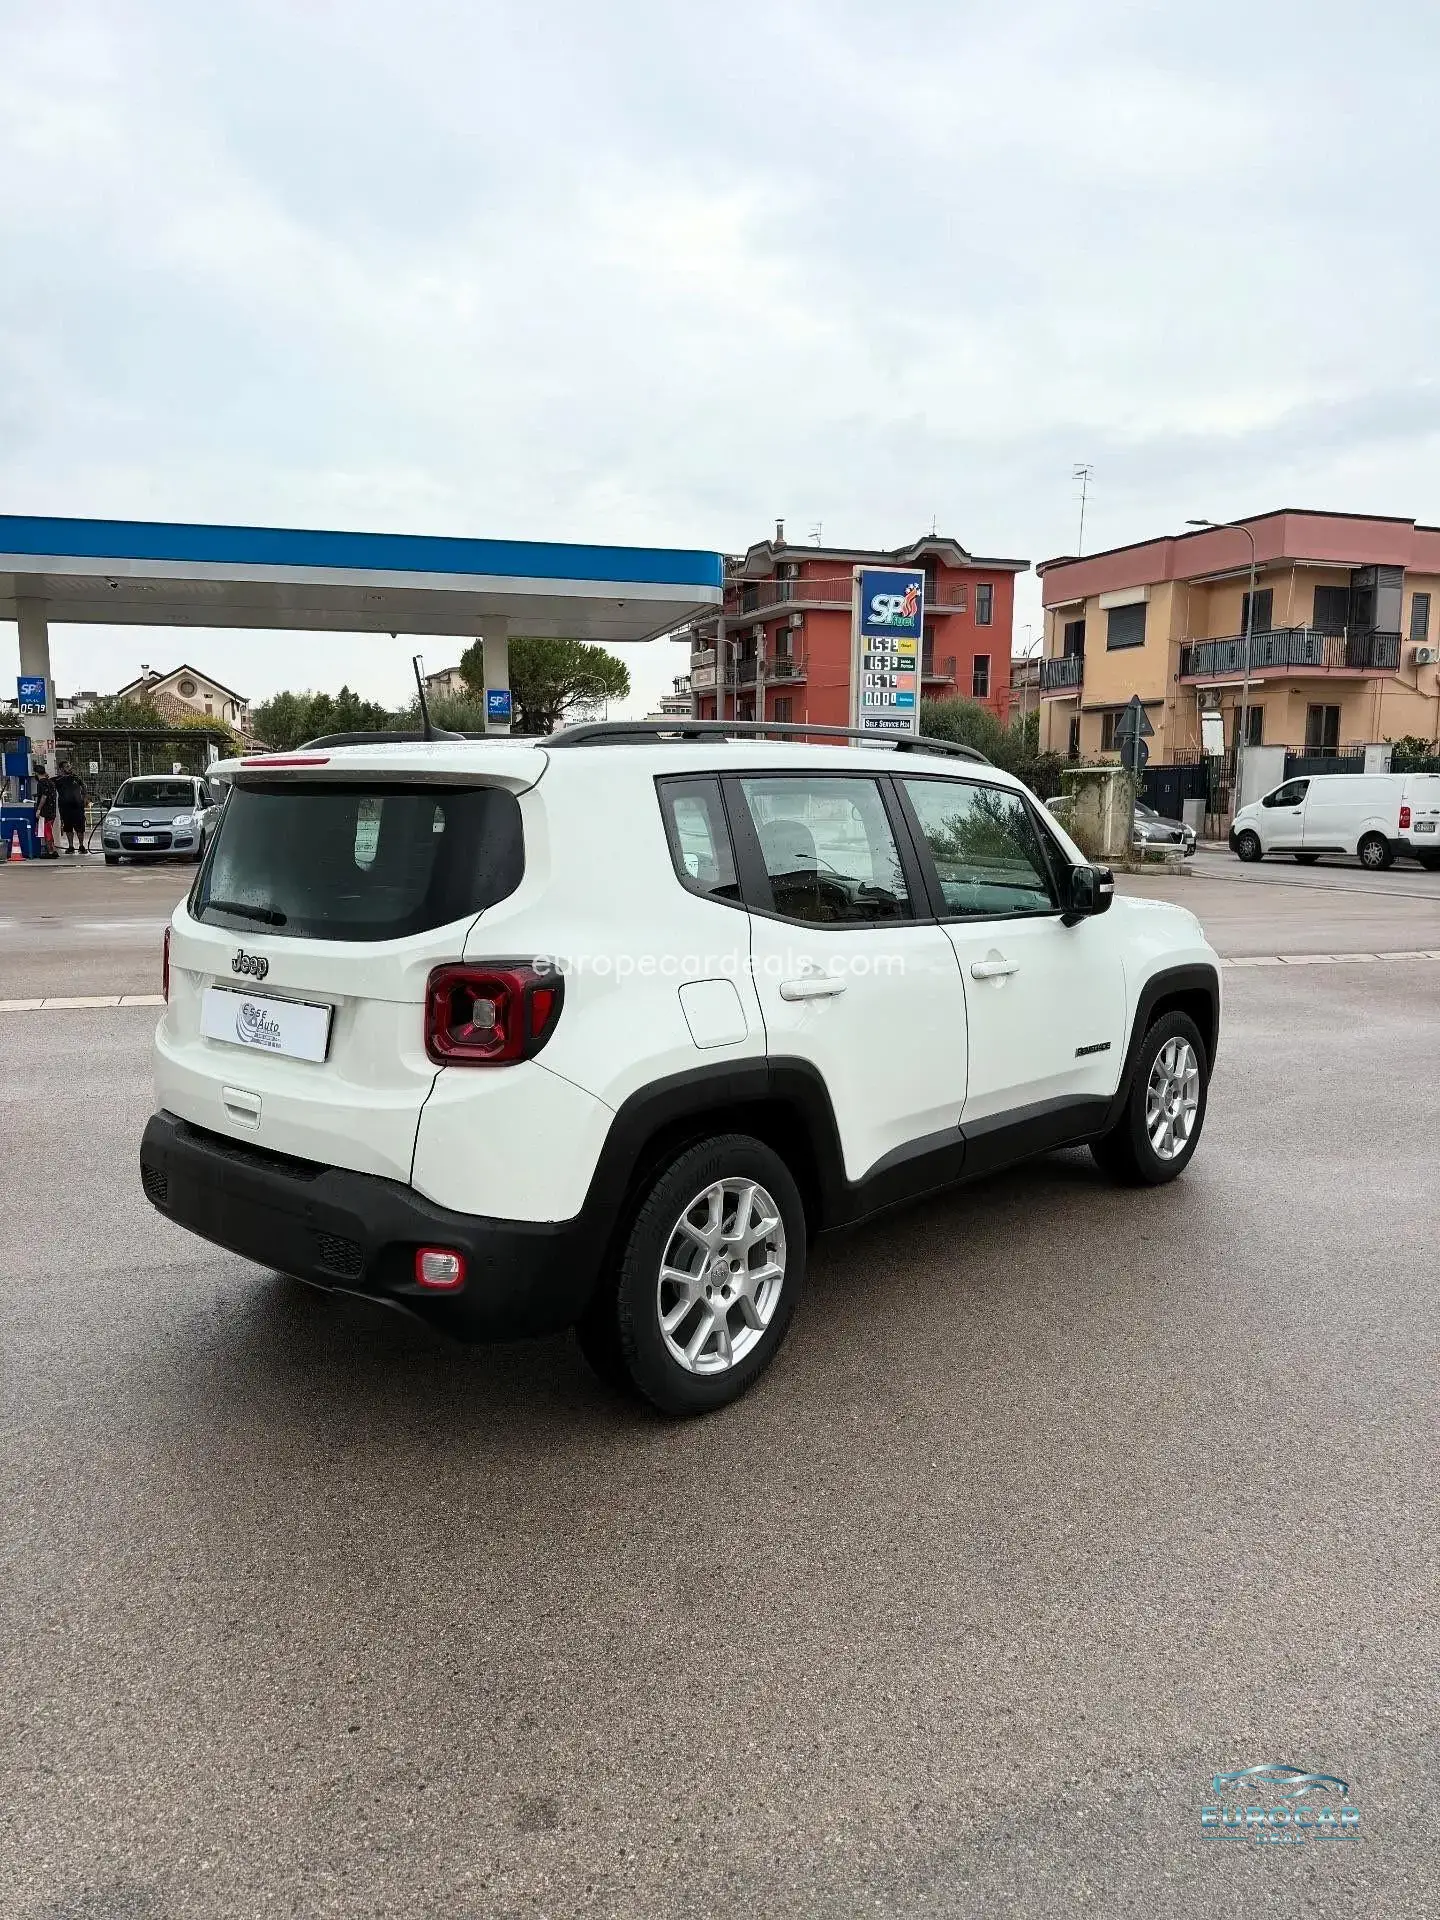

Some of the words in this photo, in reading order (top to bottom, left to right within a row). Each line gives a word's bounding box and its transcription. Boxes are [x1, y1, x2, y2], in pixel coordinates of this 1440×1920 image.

[867, 593, 906, 624] SP
[892, 615, 915, 627] fuel
[20, 683, 36, 695] SP
[490, 696, 504, 706] SP
[231, 948, 270, 981] Jeep
[256, 1018, 280, 1033] Auto
